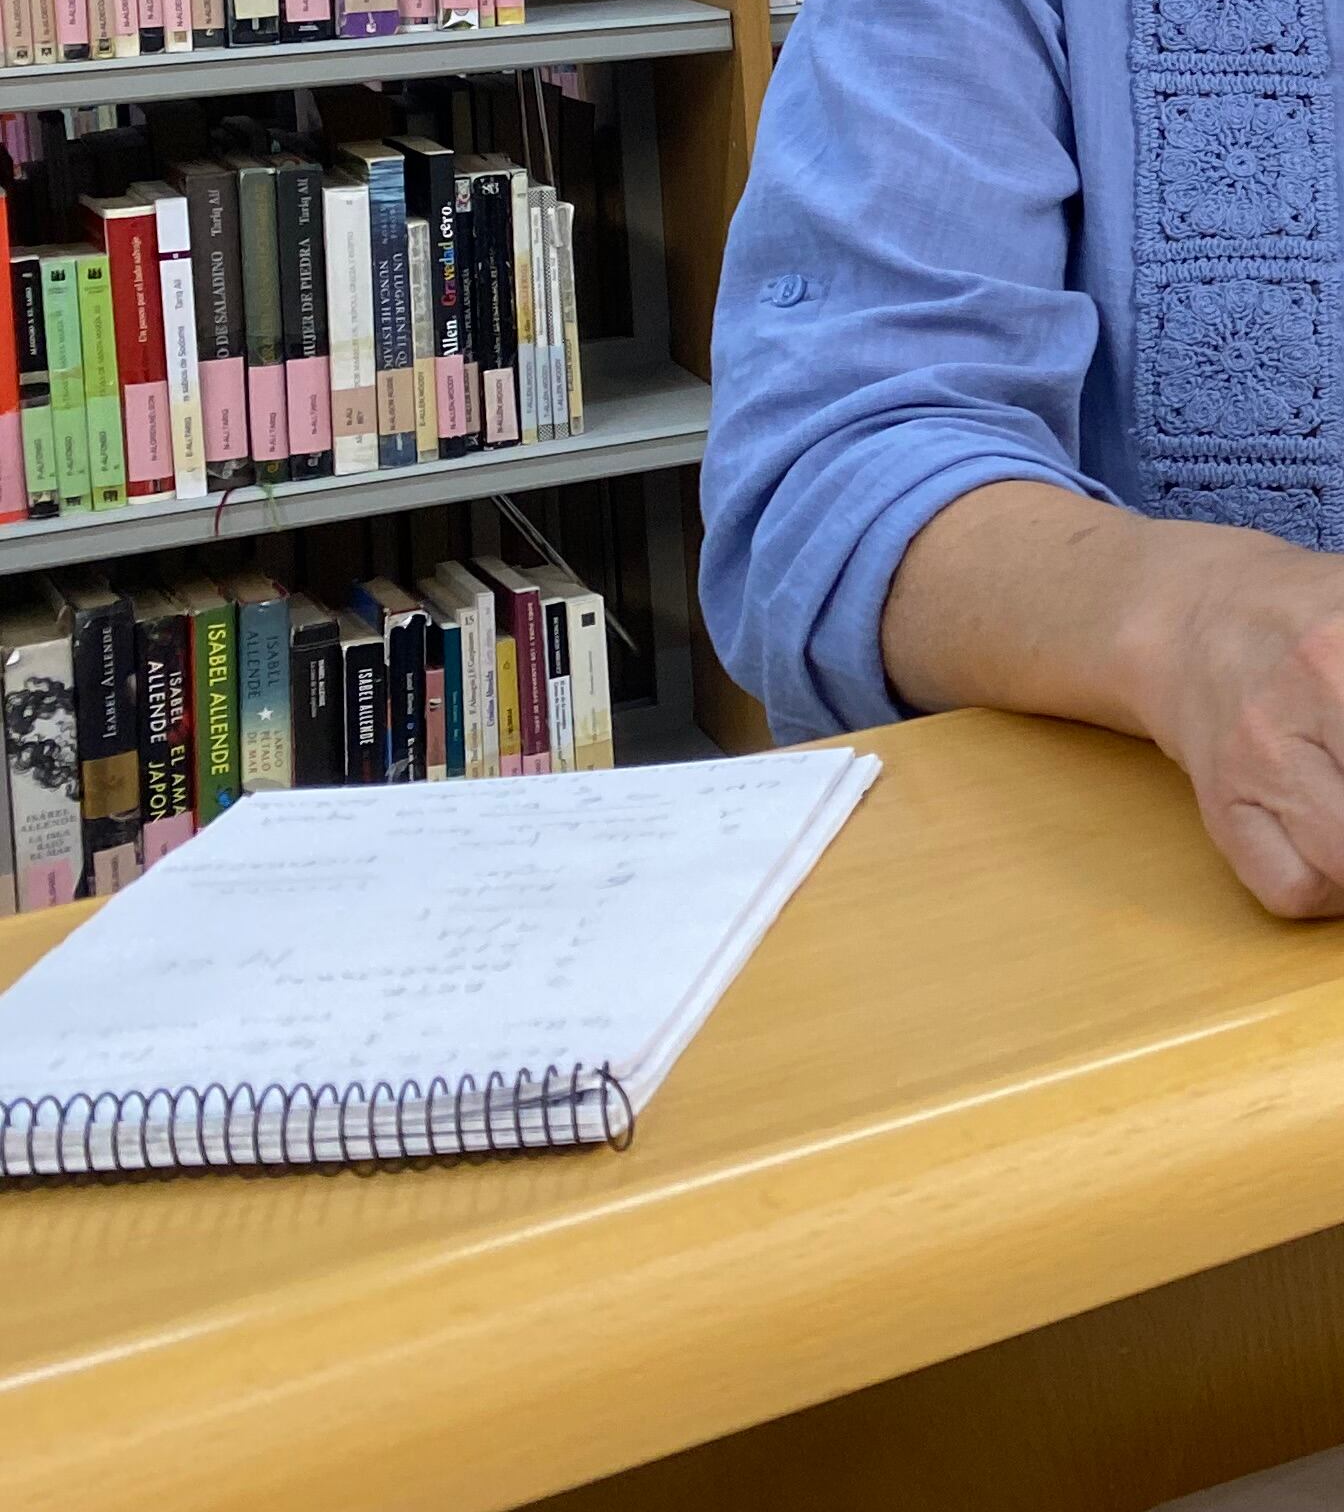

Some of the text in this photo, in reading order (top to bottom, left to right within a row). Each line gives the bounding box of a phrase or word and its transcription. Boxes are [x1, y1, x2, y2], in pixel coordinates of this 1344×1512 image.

[211, 251, 228, 326] SALADINO
[299, 238, 314, 293] PIEDRA
[439, 202, 457, 307] Gravedad cero.
[100, 626, 117, 739] ISABEL ALLENDE
[168, 671, 184, 724] ISABEL
[266, 636, 281, 687] ISABEL
[147, 660, 168, 744] ALLENDE
[207, 623, 230, 777] ISABEL ALLENDE
[358, 668, 375, 746] ISABEL ALLENDE
[170, 745, 186, 766] EL
